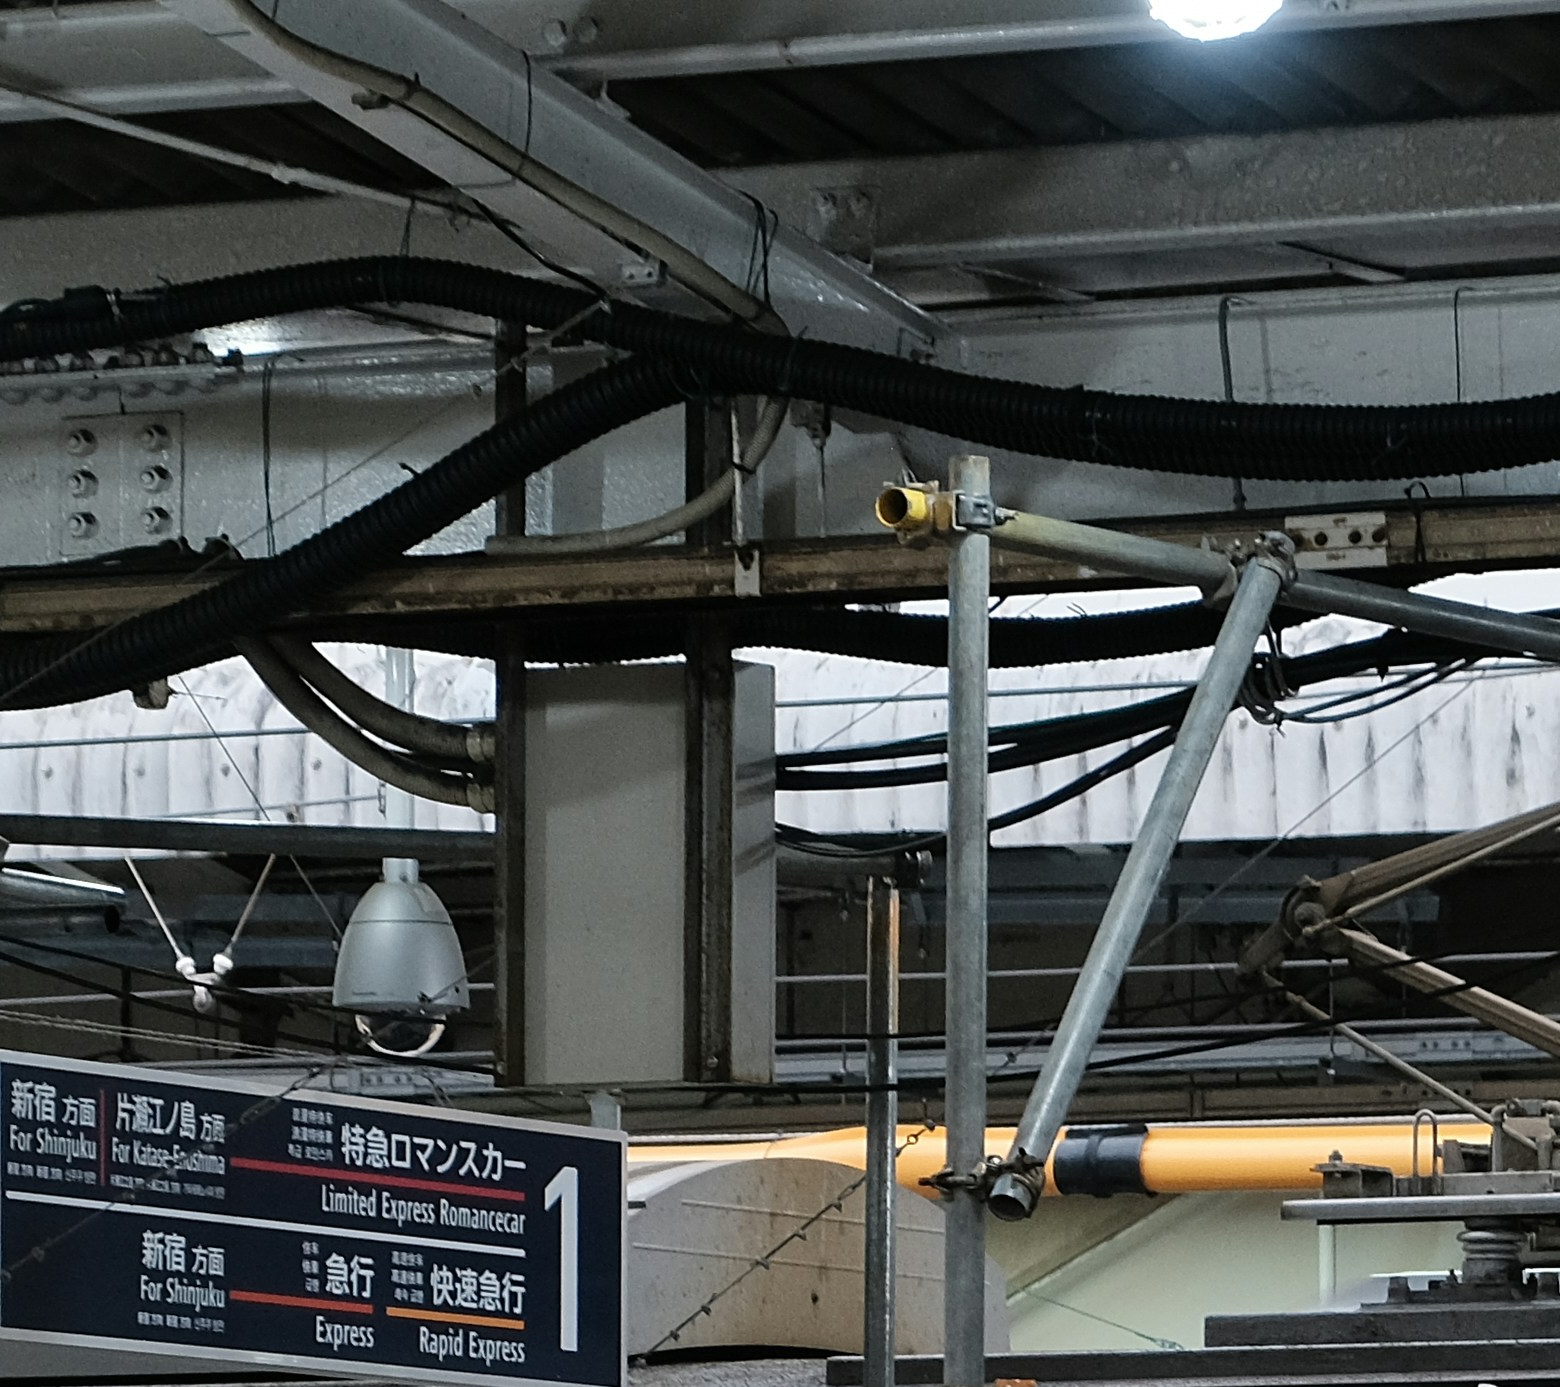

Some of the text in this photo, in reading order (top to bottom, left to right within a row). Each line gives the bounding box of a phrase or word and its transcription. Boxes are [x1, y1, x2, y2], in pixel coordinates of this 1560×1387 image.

[11, 1079, 97, 1128] 新宿 方面
[116, 1093, 226, 1144] 片瀬江ノ島 方面
[10, 1125, 97, 1163] For Shinjuku
[112, 1137, 131, 1163] For
[341, 1122, 527, 1182] 特急ロマンスカー
[321, 1184, 527, 1235] Limited Express Romancecar
[142, 1230, 225, 1277] 新宿 方面
[325, 1252, 376, 1299] 急行
[544, 1166, 578, 1352] 1
[141, 1275, 226, 1312] For Shinjuku
[430, 1263, 527, 1315] 快速急行
[315, 1315, 375, 1351] Express
[419, 1326, 526, 1367] Rapid Express
